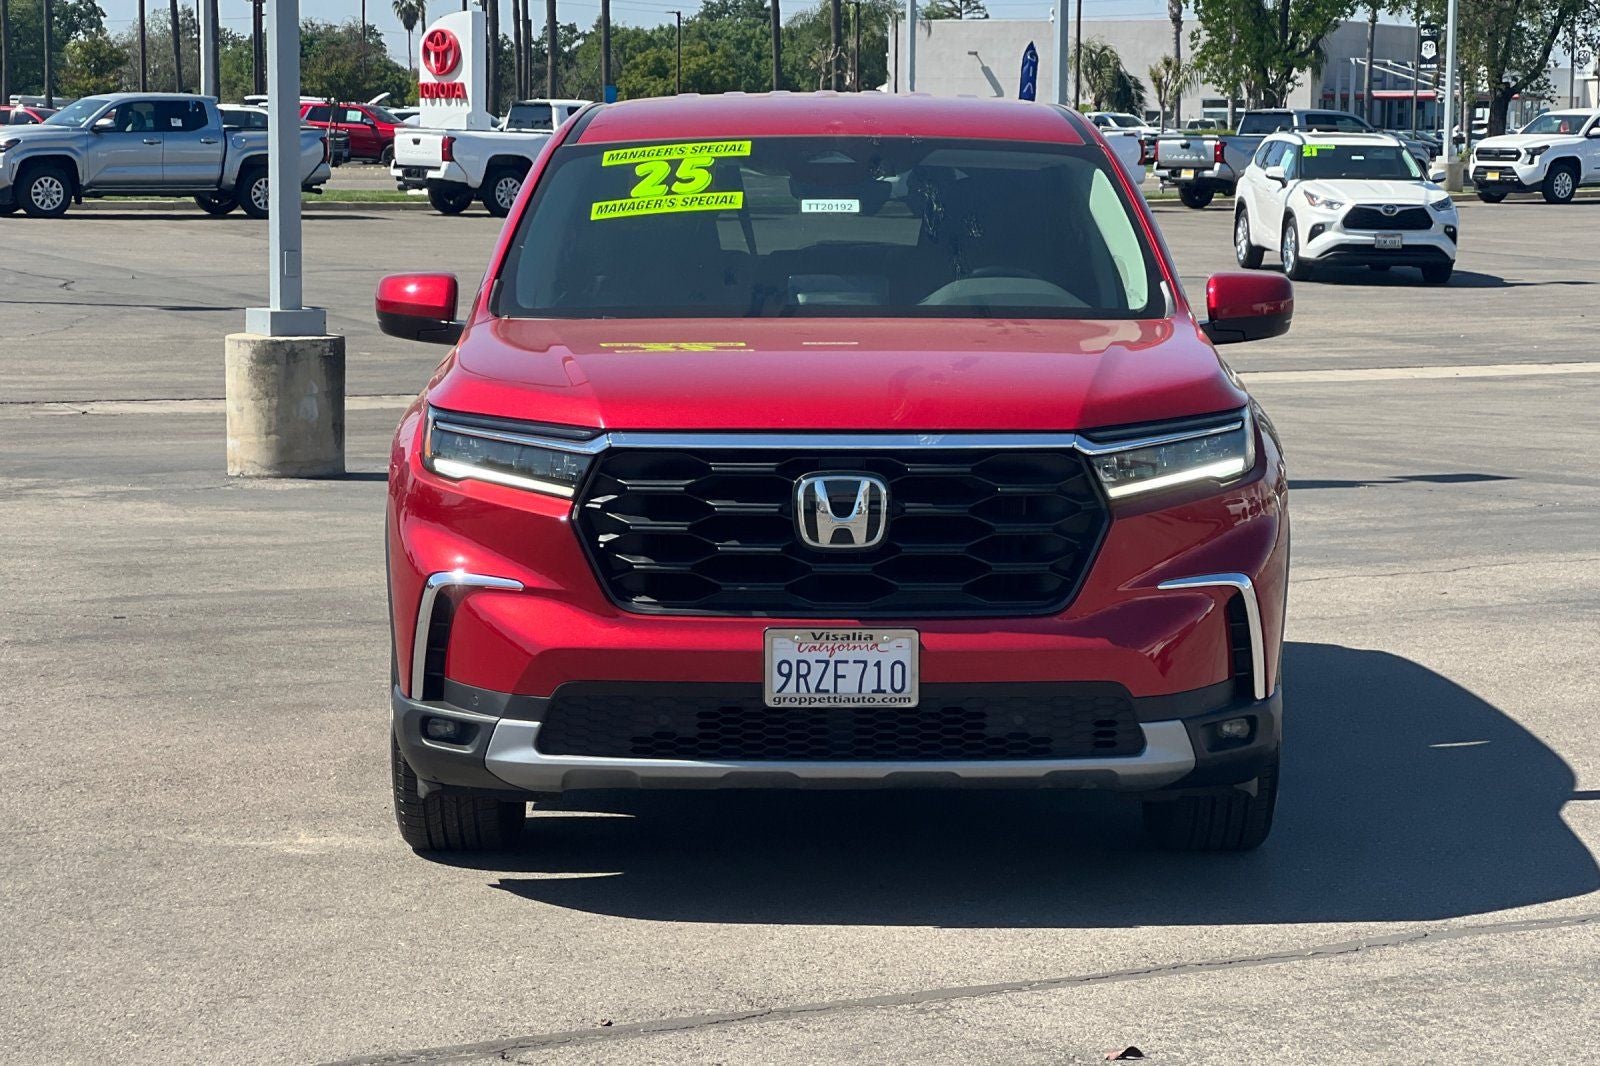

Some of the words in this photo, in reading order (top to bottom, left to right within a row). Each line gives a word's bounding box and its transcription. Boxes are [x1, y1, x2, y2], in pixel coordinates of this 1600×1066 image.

[418, 82, 465, 99] TOYOTA
[607, 147, 687, 162] MANAGER'S
[690, 143, 745, 154] SPECIAL
[630, 156, 715, 198] 25
[596, 197, 676, 215] MANAGER'S
[681, 194, 737, 206] SPECIAL
[806, 202, 854, 211] TT20192
[811, 631, 874, 641] Visalia
[797, 642, 889, 658] California
[776, 659, 906, 694] 9RZF710
[773, 694, 911, 705] groppettiauto.com
